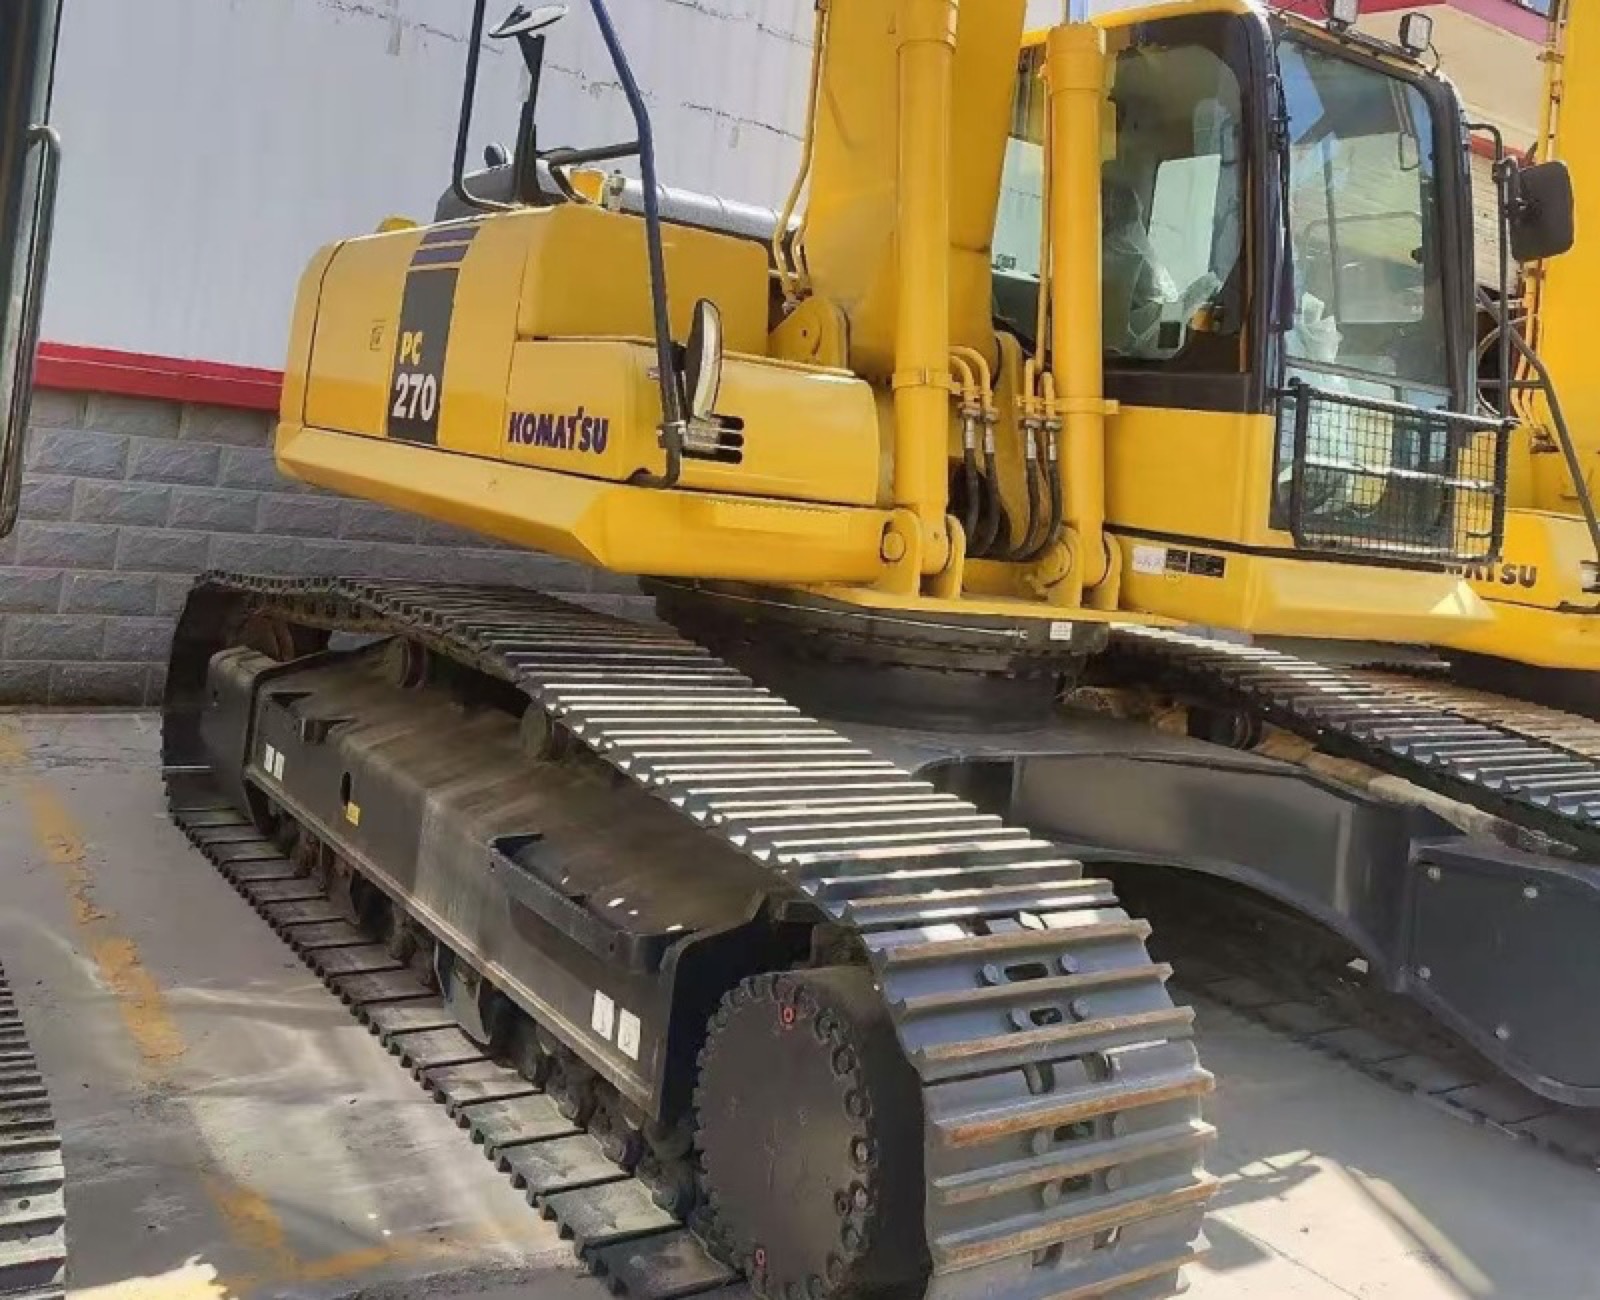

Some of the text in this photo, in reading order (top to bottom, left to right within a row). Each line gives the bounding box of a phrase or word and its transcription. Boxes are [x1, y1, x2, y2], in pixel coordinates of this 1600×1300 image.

[399, 332, 423, 364] PC
[391, 373, 437, 421] 270
[508, 406, 608, 454] KOMATSU
